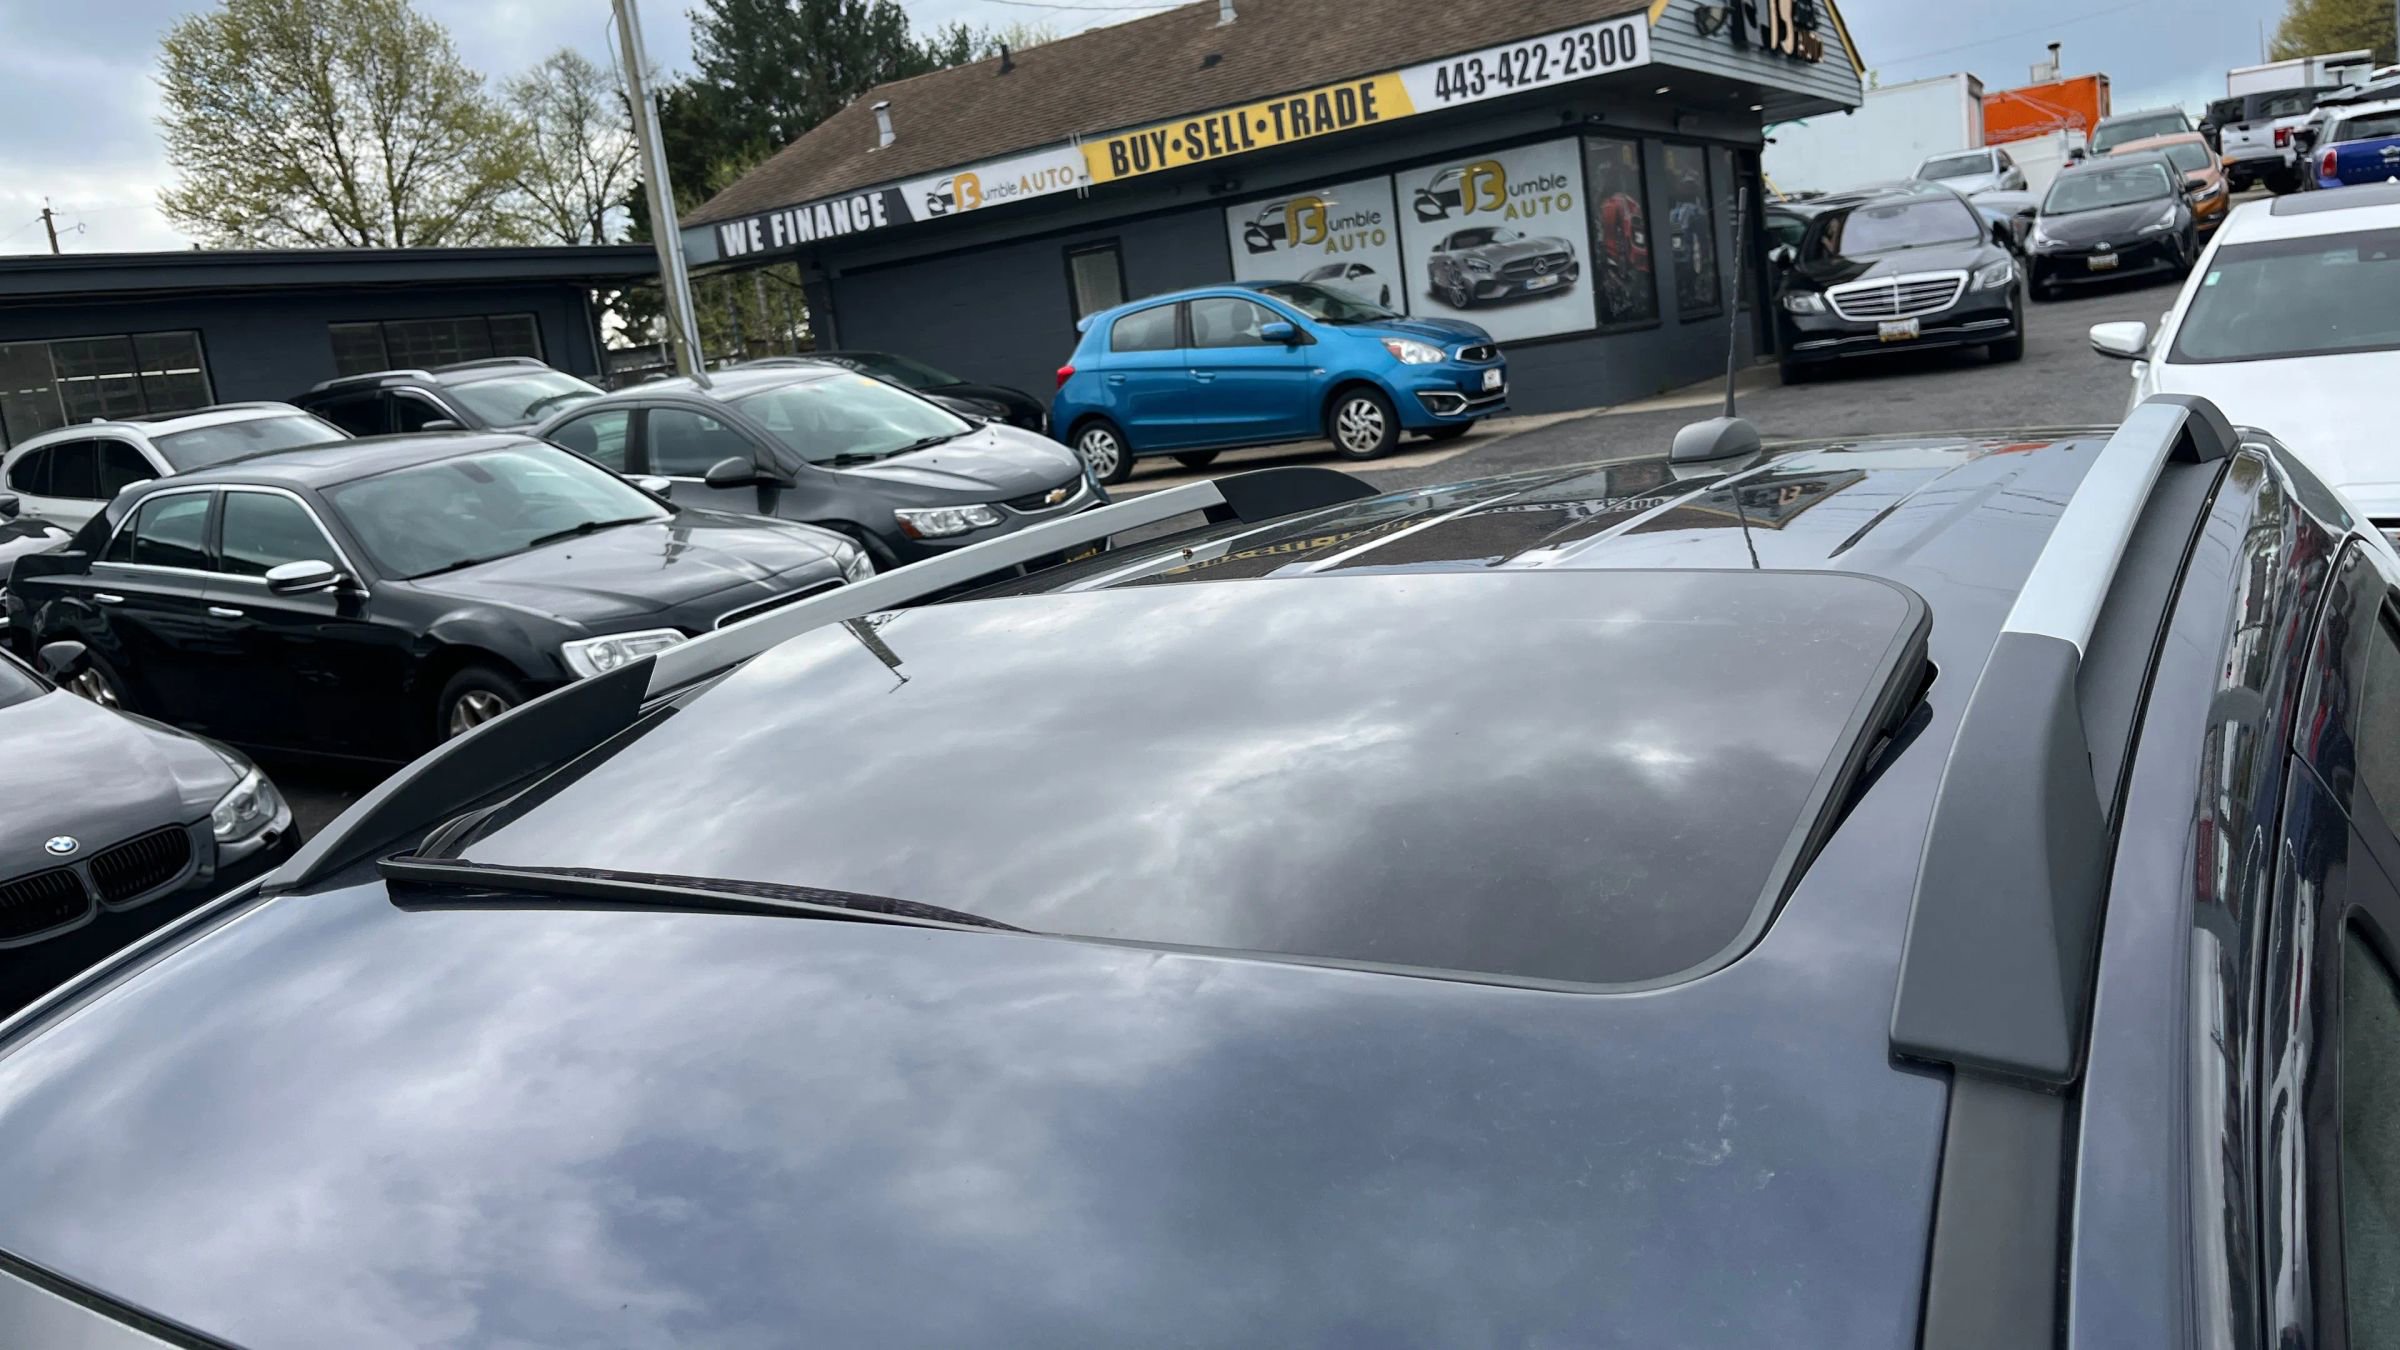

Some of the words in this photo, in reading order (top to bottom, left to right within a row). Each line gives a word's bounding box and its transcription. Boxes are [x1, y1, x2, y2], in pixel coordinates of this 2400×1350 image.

[1435, 23, 1636, 101] 443-422-2300
[1109, 130, 1167, 177] BUY
[1184, 111, 1255, 160] SELL
[1268, 81, 1379, 141] TRADE
[1019, 166, 1074, 195] AUTO
[720, 218, 765, 257] WE
[770, 192, 888, 247] FINANCE
[1504, 192, 1573, 222] AUTO
[1324, 228, 1386, 255] AUTO
